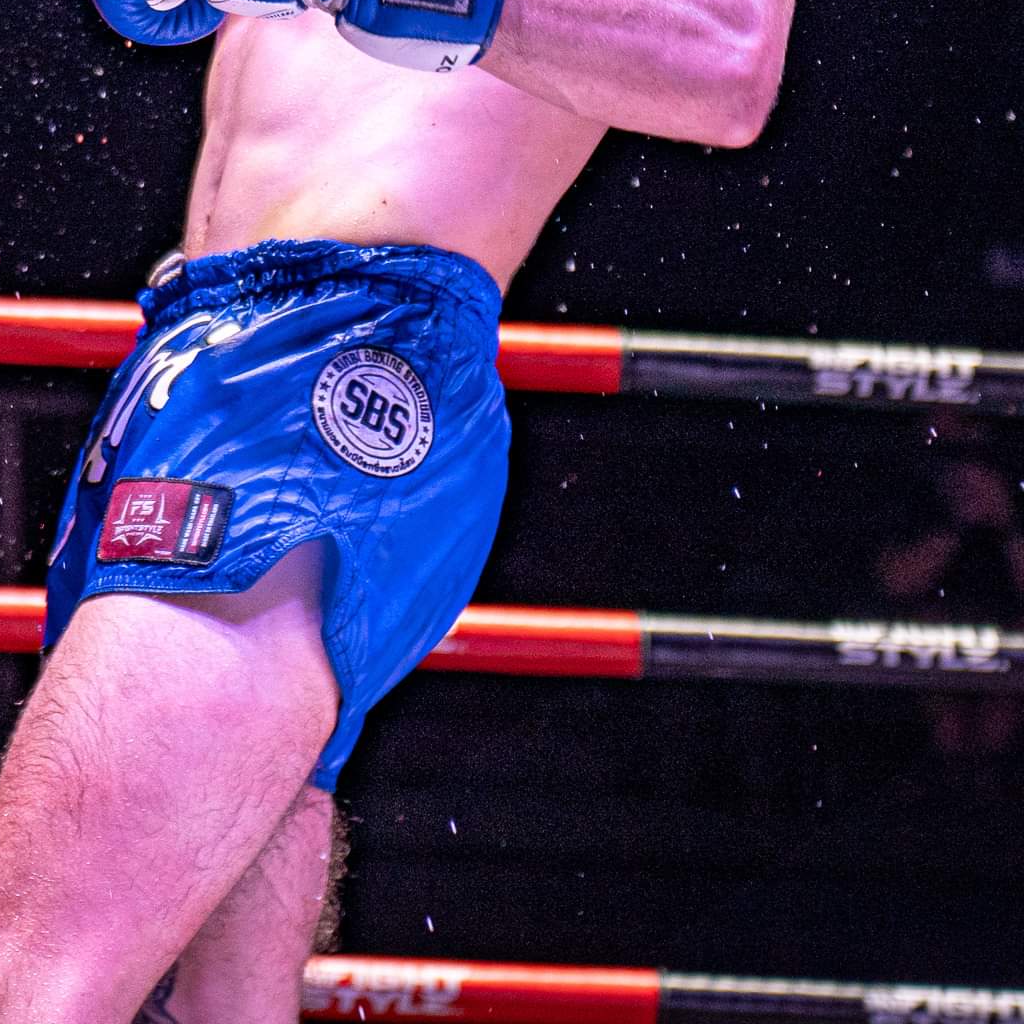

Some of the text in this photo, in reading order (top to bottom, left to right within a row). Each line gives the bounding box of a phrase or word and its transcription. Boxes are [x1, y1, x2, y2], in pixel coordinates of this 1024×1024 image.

[340, 378, 410, 446] SBS
[364, 350, 404, 374] BOXING
[403, 369, 431, 423] STADIUM
